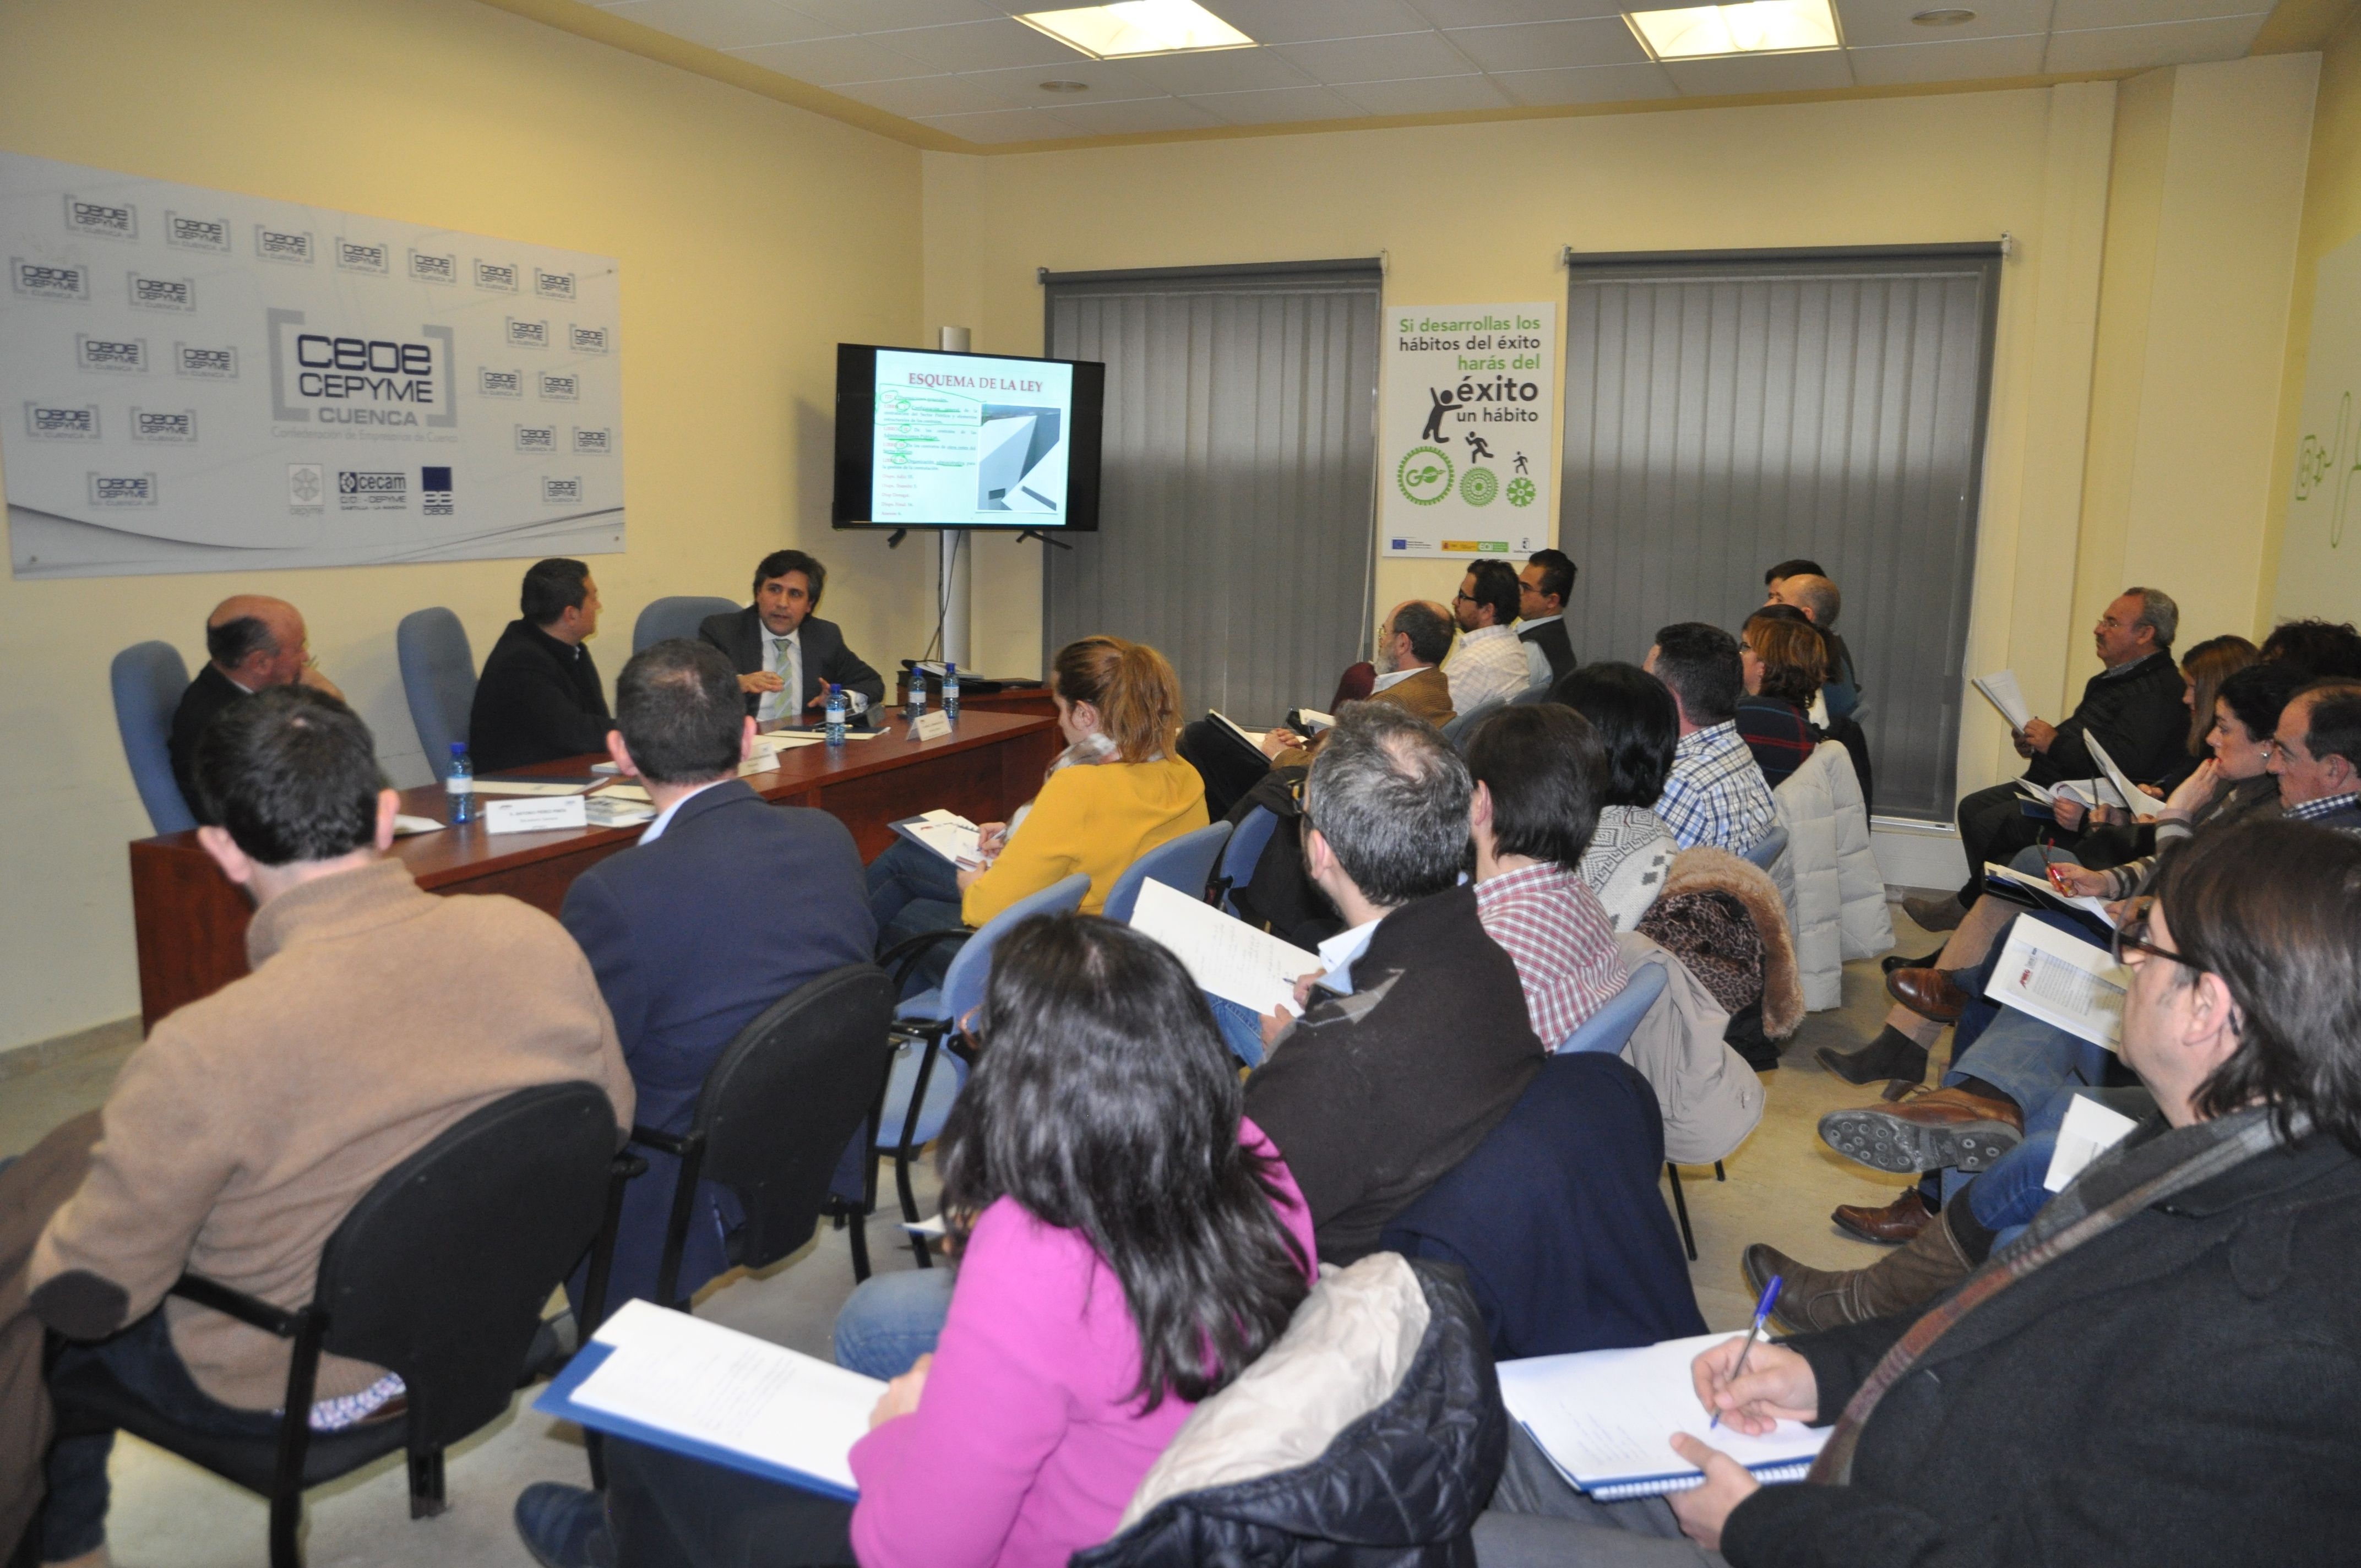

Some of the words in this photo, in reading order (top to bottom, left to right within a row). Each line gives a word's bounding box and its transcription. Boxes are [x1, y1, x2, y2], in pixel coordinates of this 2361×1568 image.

[1400, 318, 1414, 333] Si
[1419, 315, 1511, 332] desarrollas
[1516, 315, 1541, 330] los
[1399, 336, 1460, 351] hábitos
[1466, 335, 1492, 350] del
[1498, 335, 1541, 350] éxito
[1458, 355, 1506, 371] harás
[1512, 353, 1541, 369] del
[299, 372, 433, 403] CEPYME
[909, 373, 975, 388] ESQUEMA
[978, 377, 997, 389] DE
[1000, 379, 1016, 390] LA
[1020, 380, 1043, 392] LEY
[1457, 374, 1538, 402] éxito
[319, 407, 418, 426] CUENCA
[1457, 412, 1477, 422] un
[1483, 407, 1538, 422] hábito
[358, 476, 406, 489] cecam
